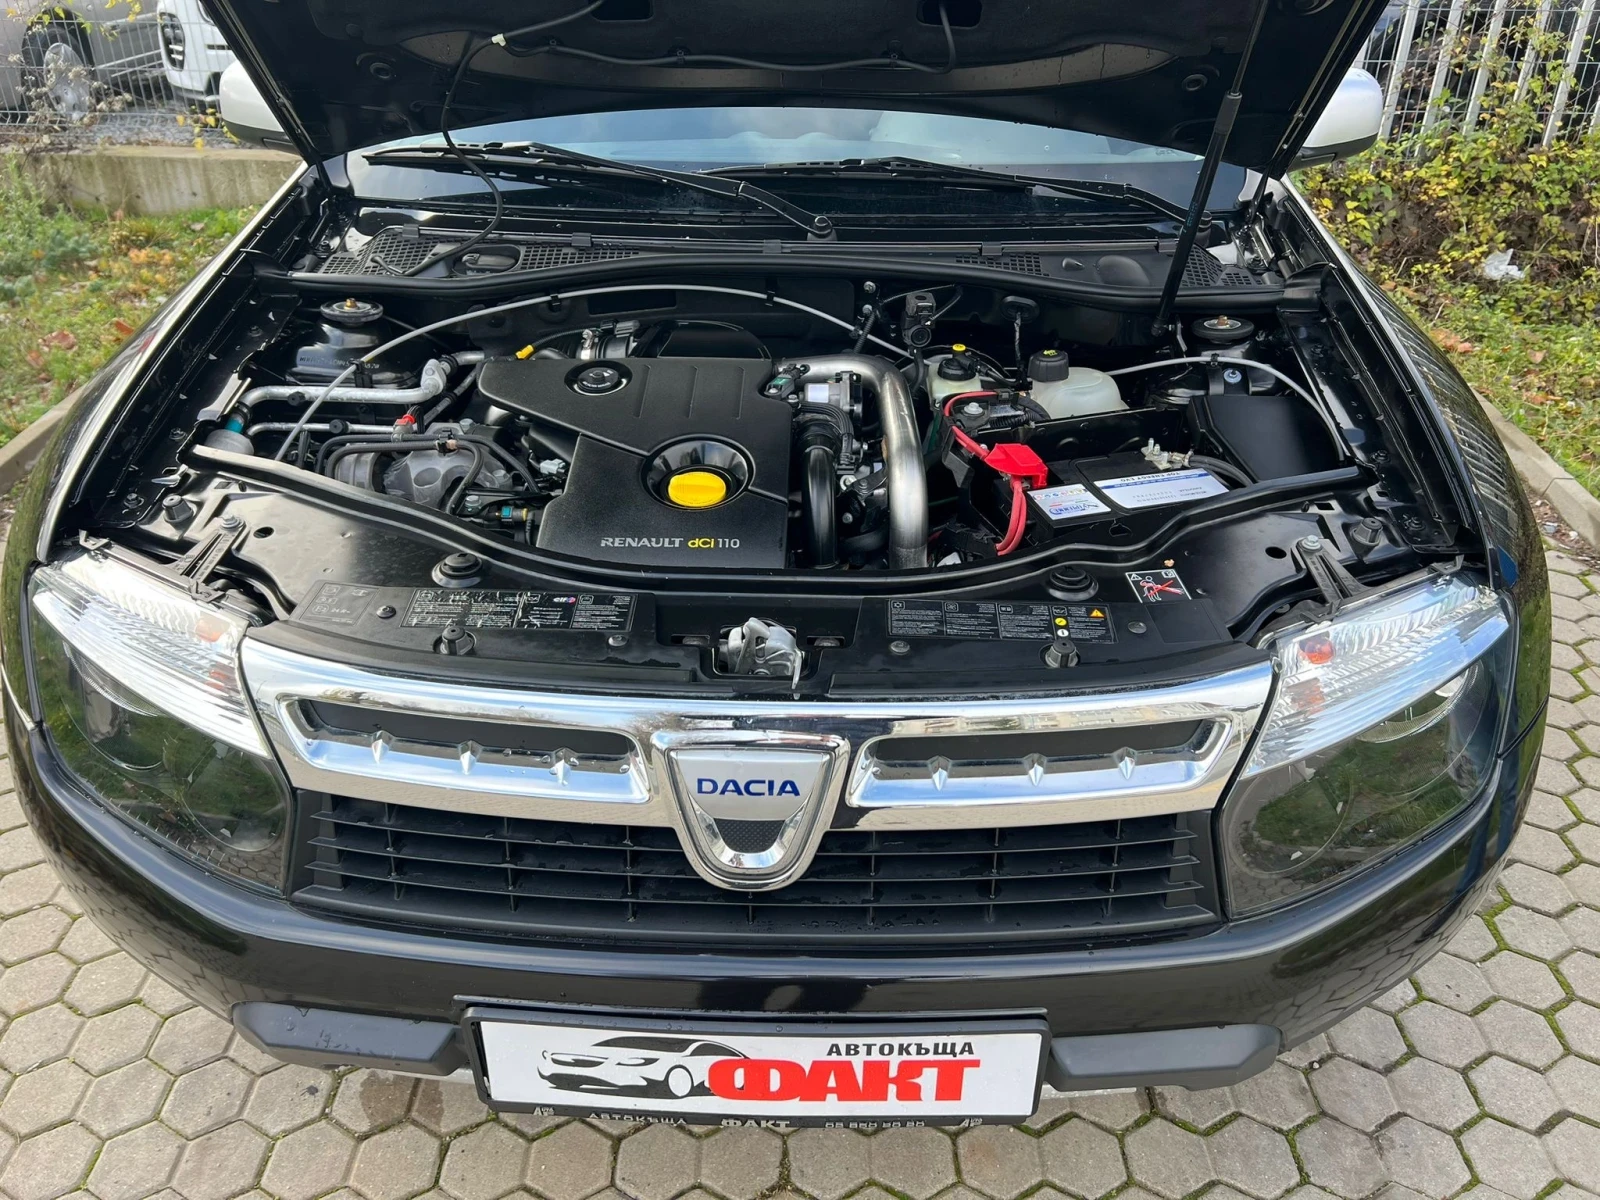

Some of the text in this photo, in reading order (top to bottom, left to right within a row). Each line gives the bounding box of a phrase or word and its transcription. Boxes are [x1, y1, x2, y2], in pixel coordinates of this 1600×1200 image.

[600, 537, 683, 548] RENAULT
[717, 538, 740, 548] 110
[697, 778, 800, 796] DACIA
[827, 1042, 974, 1057] АВТОКЪЩА
[708, 1059, 980, 1101] ФАКТ
